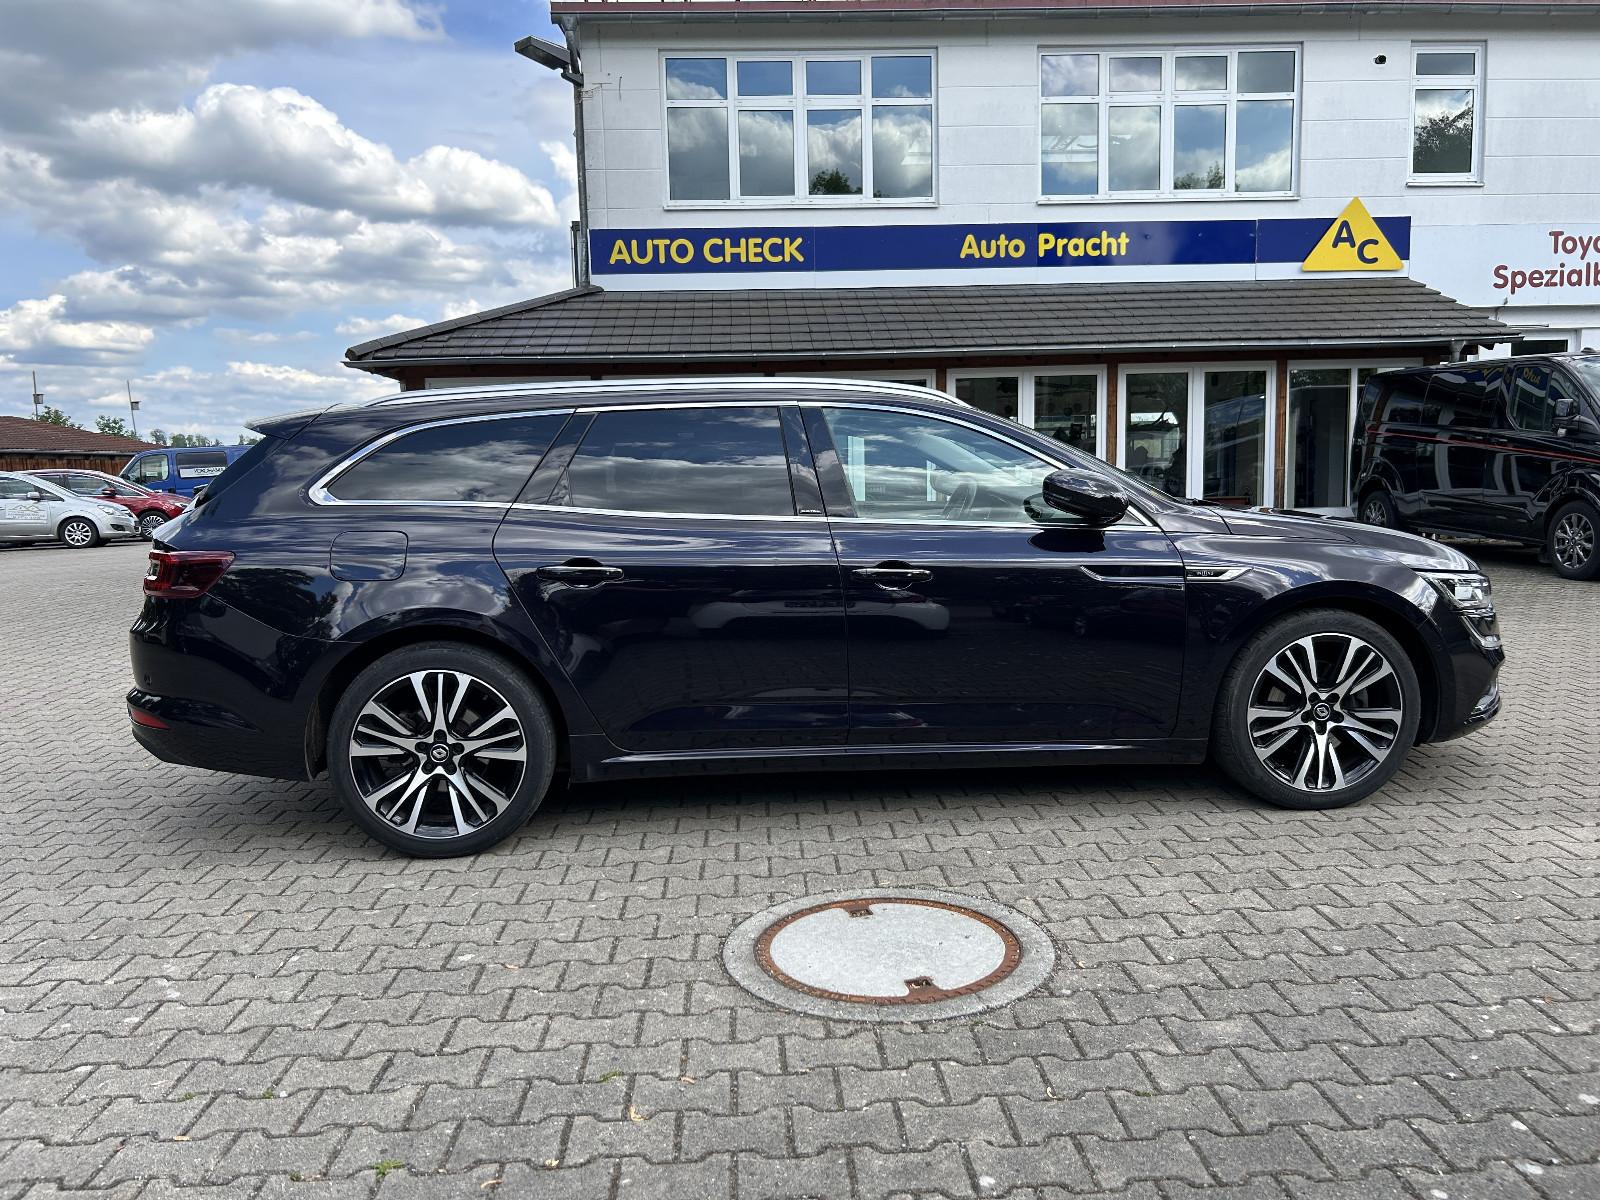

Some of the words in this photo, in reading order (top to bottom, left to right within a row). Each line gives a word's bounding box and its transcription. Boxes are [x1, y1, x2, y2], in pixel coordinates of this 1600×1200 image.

[609, 238, 694, 265] AUTO
[703, 237, 804, 264] CHECK
[959, 233, 1026, 259] Auto
[1037, 230, 1130, 258] Pracht
